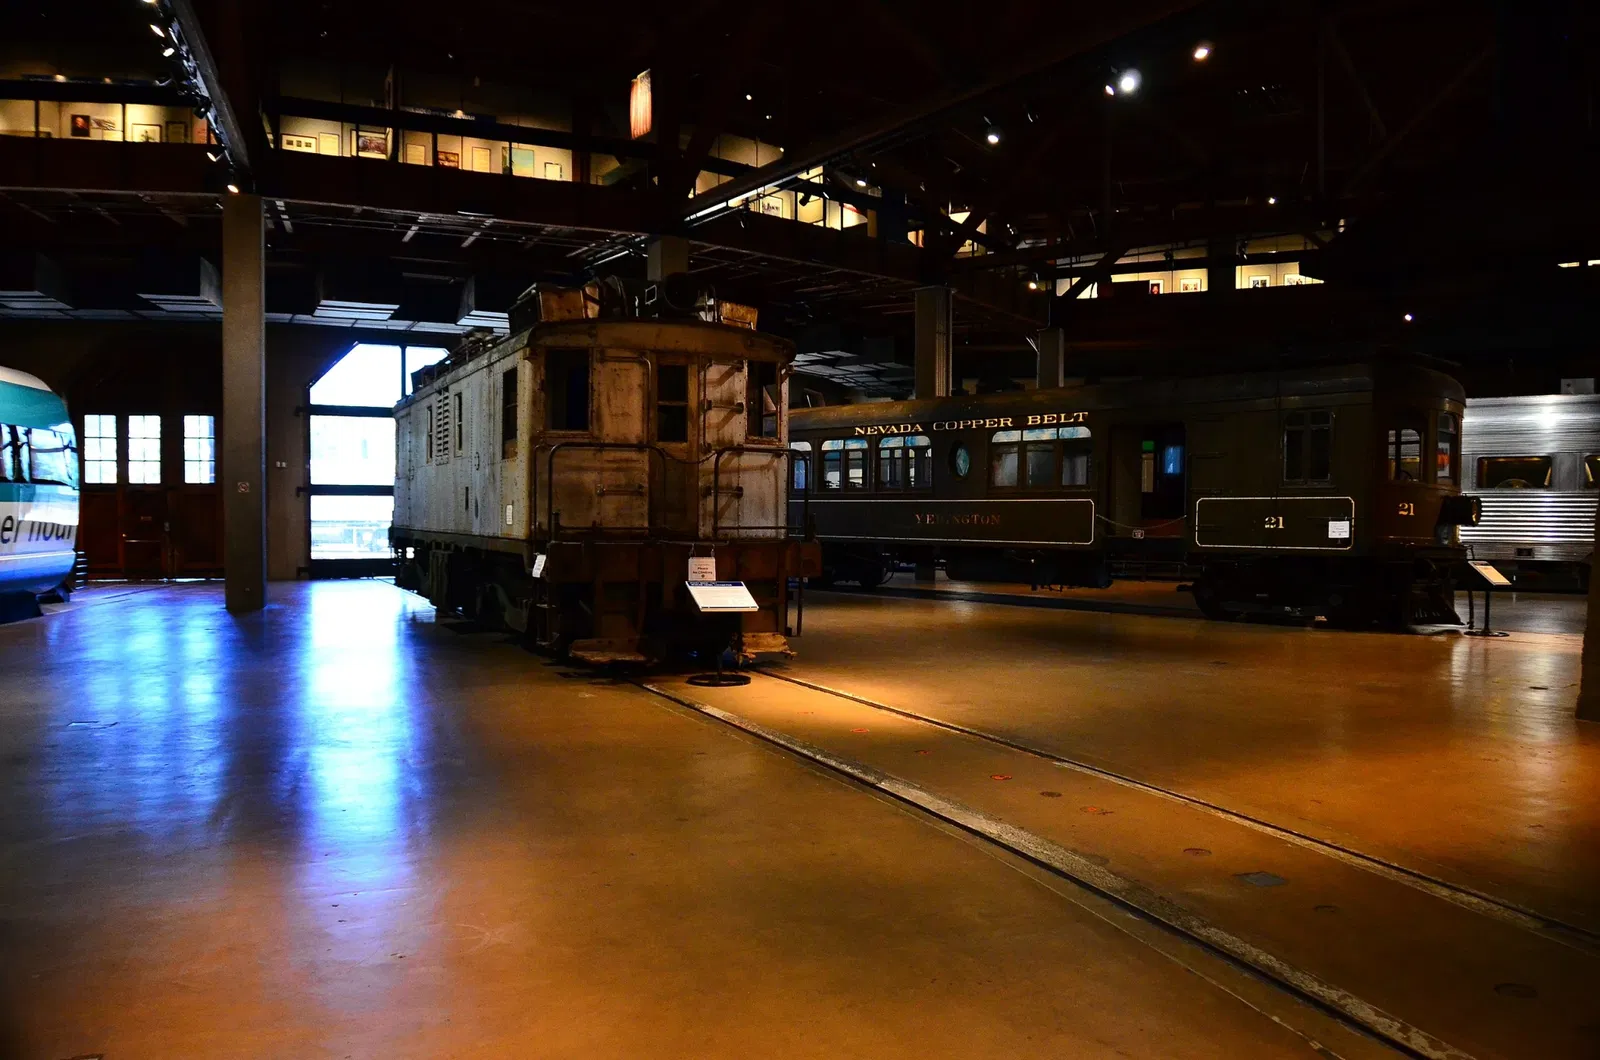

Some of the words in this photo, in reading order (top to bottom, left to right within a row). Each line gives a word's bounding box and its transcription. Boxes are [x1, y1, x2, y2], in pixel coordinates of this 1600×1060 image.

[854, 423, 924, 437] NEVADA
[933, 416, 1014, 431] COPPER
[1026, 411, 1090, 426] BELT
[1397, 502, 1416, 516] 21
[913, 512, 1001, 525] YENGTON
[1264, 516, 1285, 529] 21
